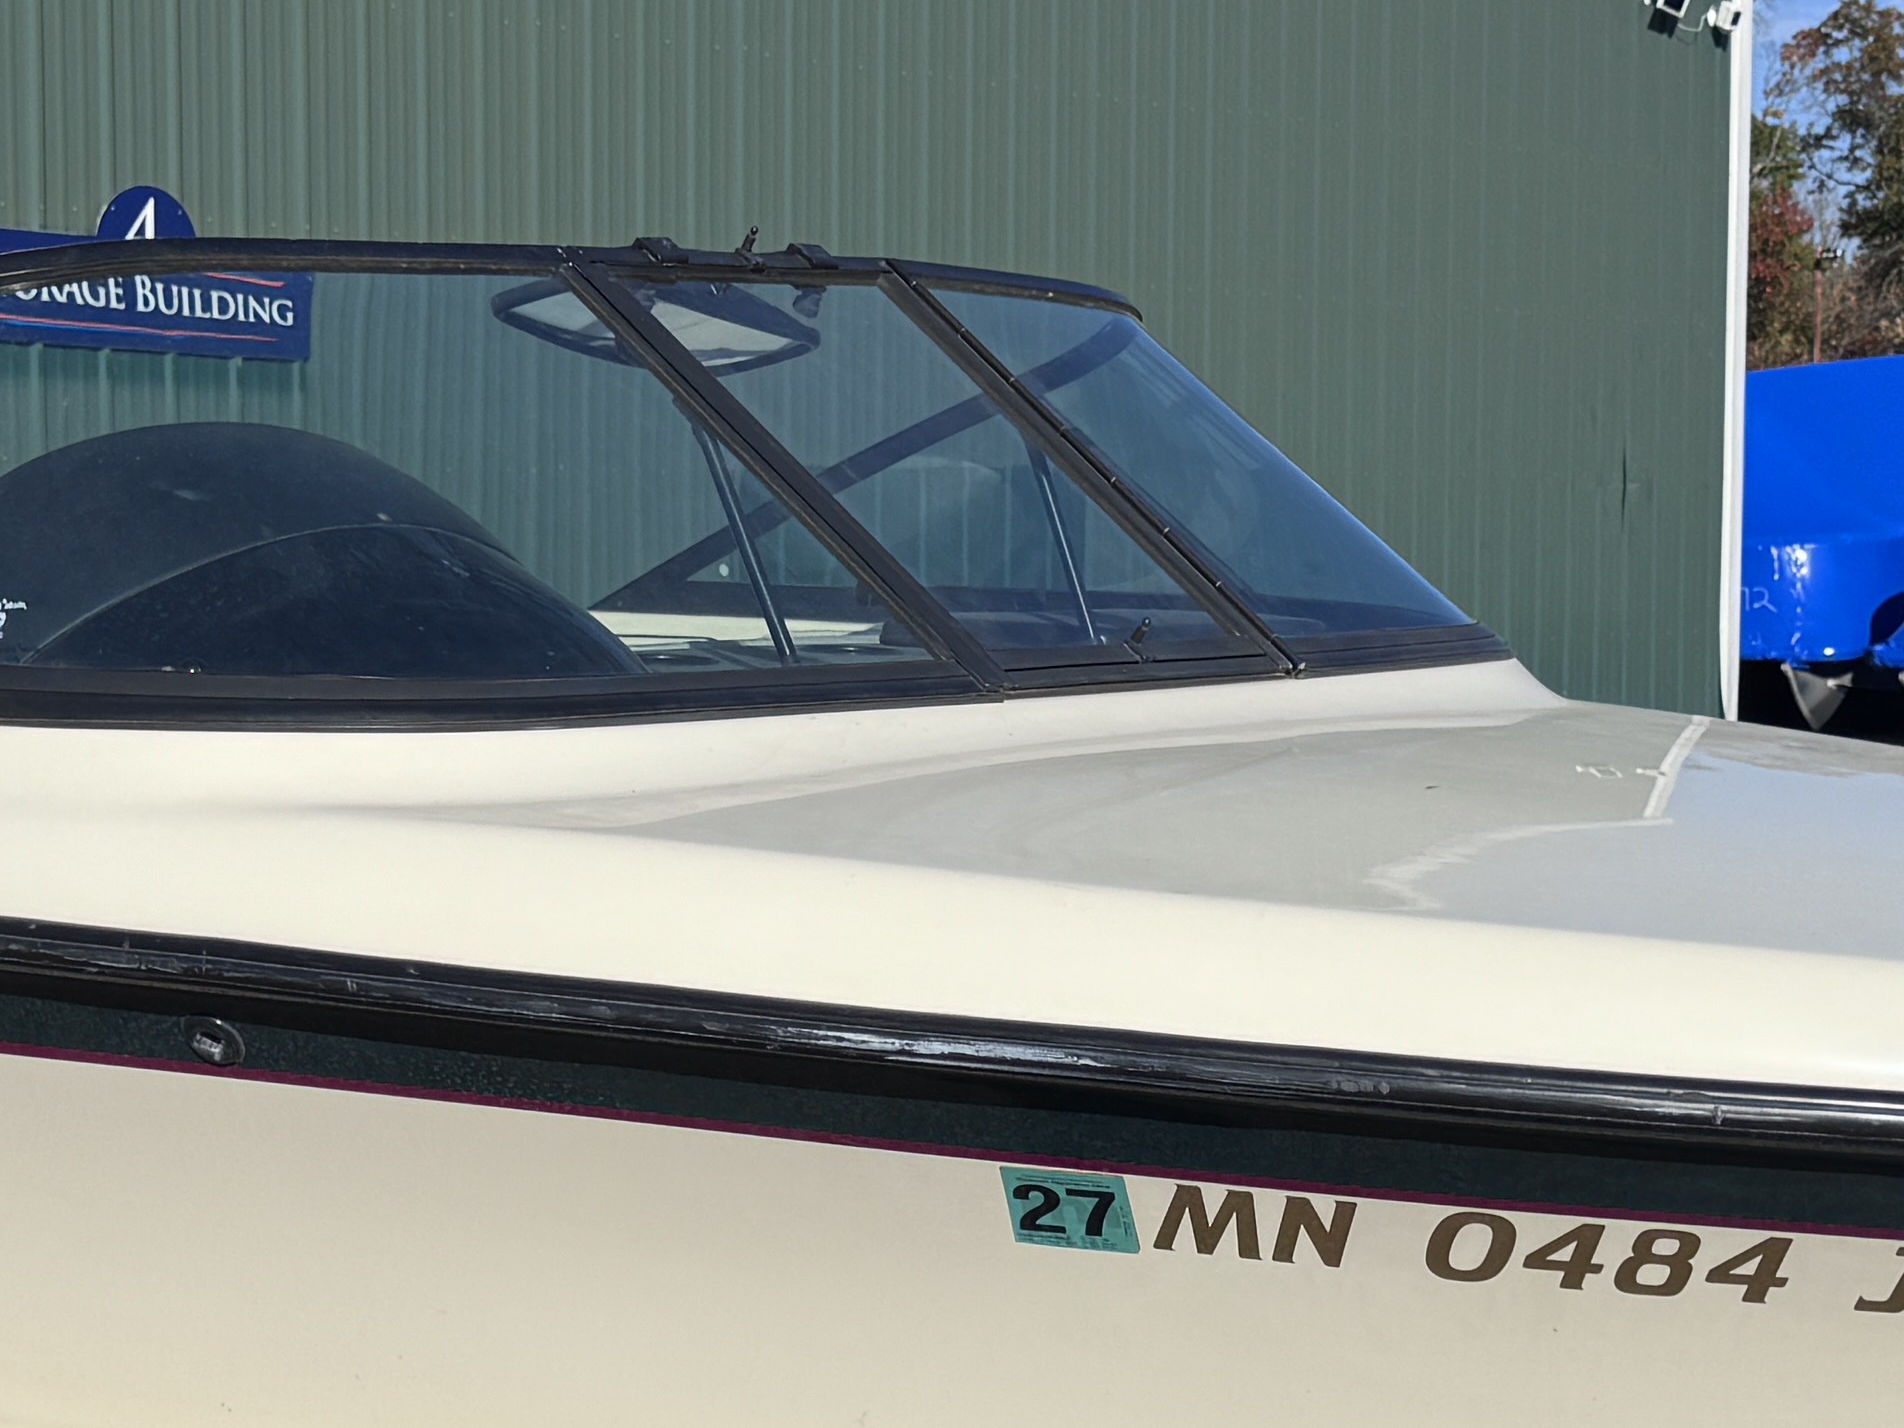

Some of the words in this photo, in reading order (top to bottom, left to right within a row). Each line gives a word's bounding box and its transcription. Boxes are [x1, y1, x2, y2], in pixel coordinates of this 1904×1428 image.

[14, 276, 127, 310] RAGE
[134, 274, 295, 327] BUILDING
[1012, 1183, 1116, 1238] 27
[1153, 1183, 1358, 1268] MN
[1425, 1211, 1794, 1304] 0484
